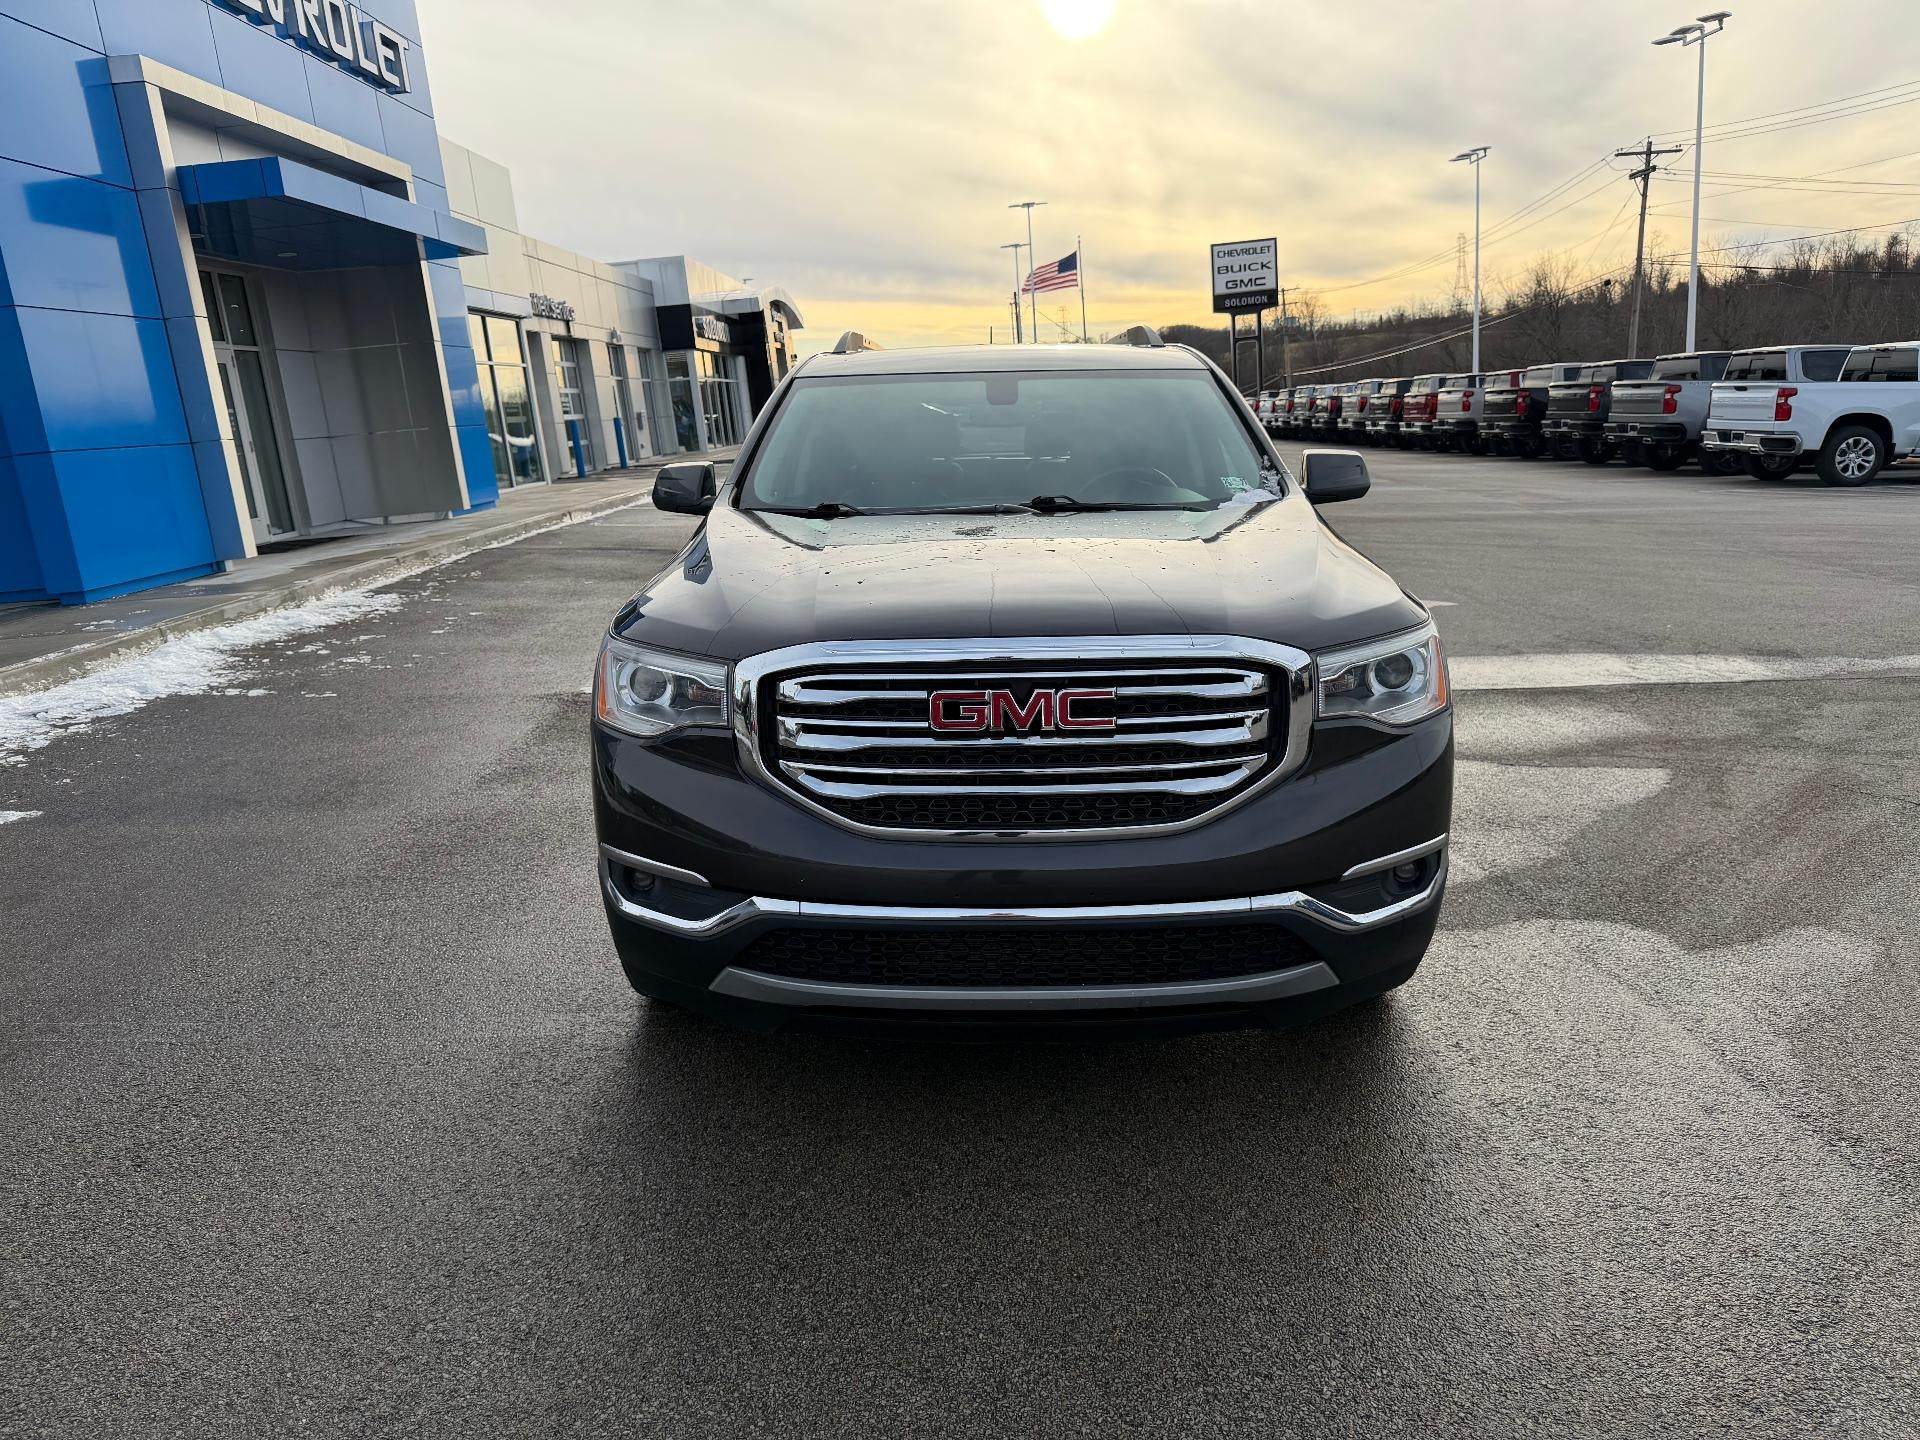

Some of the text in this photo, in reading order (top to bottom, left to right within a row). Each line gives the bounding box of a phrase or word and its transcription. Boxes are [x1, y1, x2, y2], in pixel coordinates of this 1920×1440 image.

[1217, 245, 1271, 258] CHEVROLET
[1217, 261, 1272, 275] BUICK
[1225, 276, 1266, 290] GMC
[1225, 295, 1268, 307] SOLOMON
[930, 688, 1116, 731] GMC
